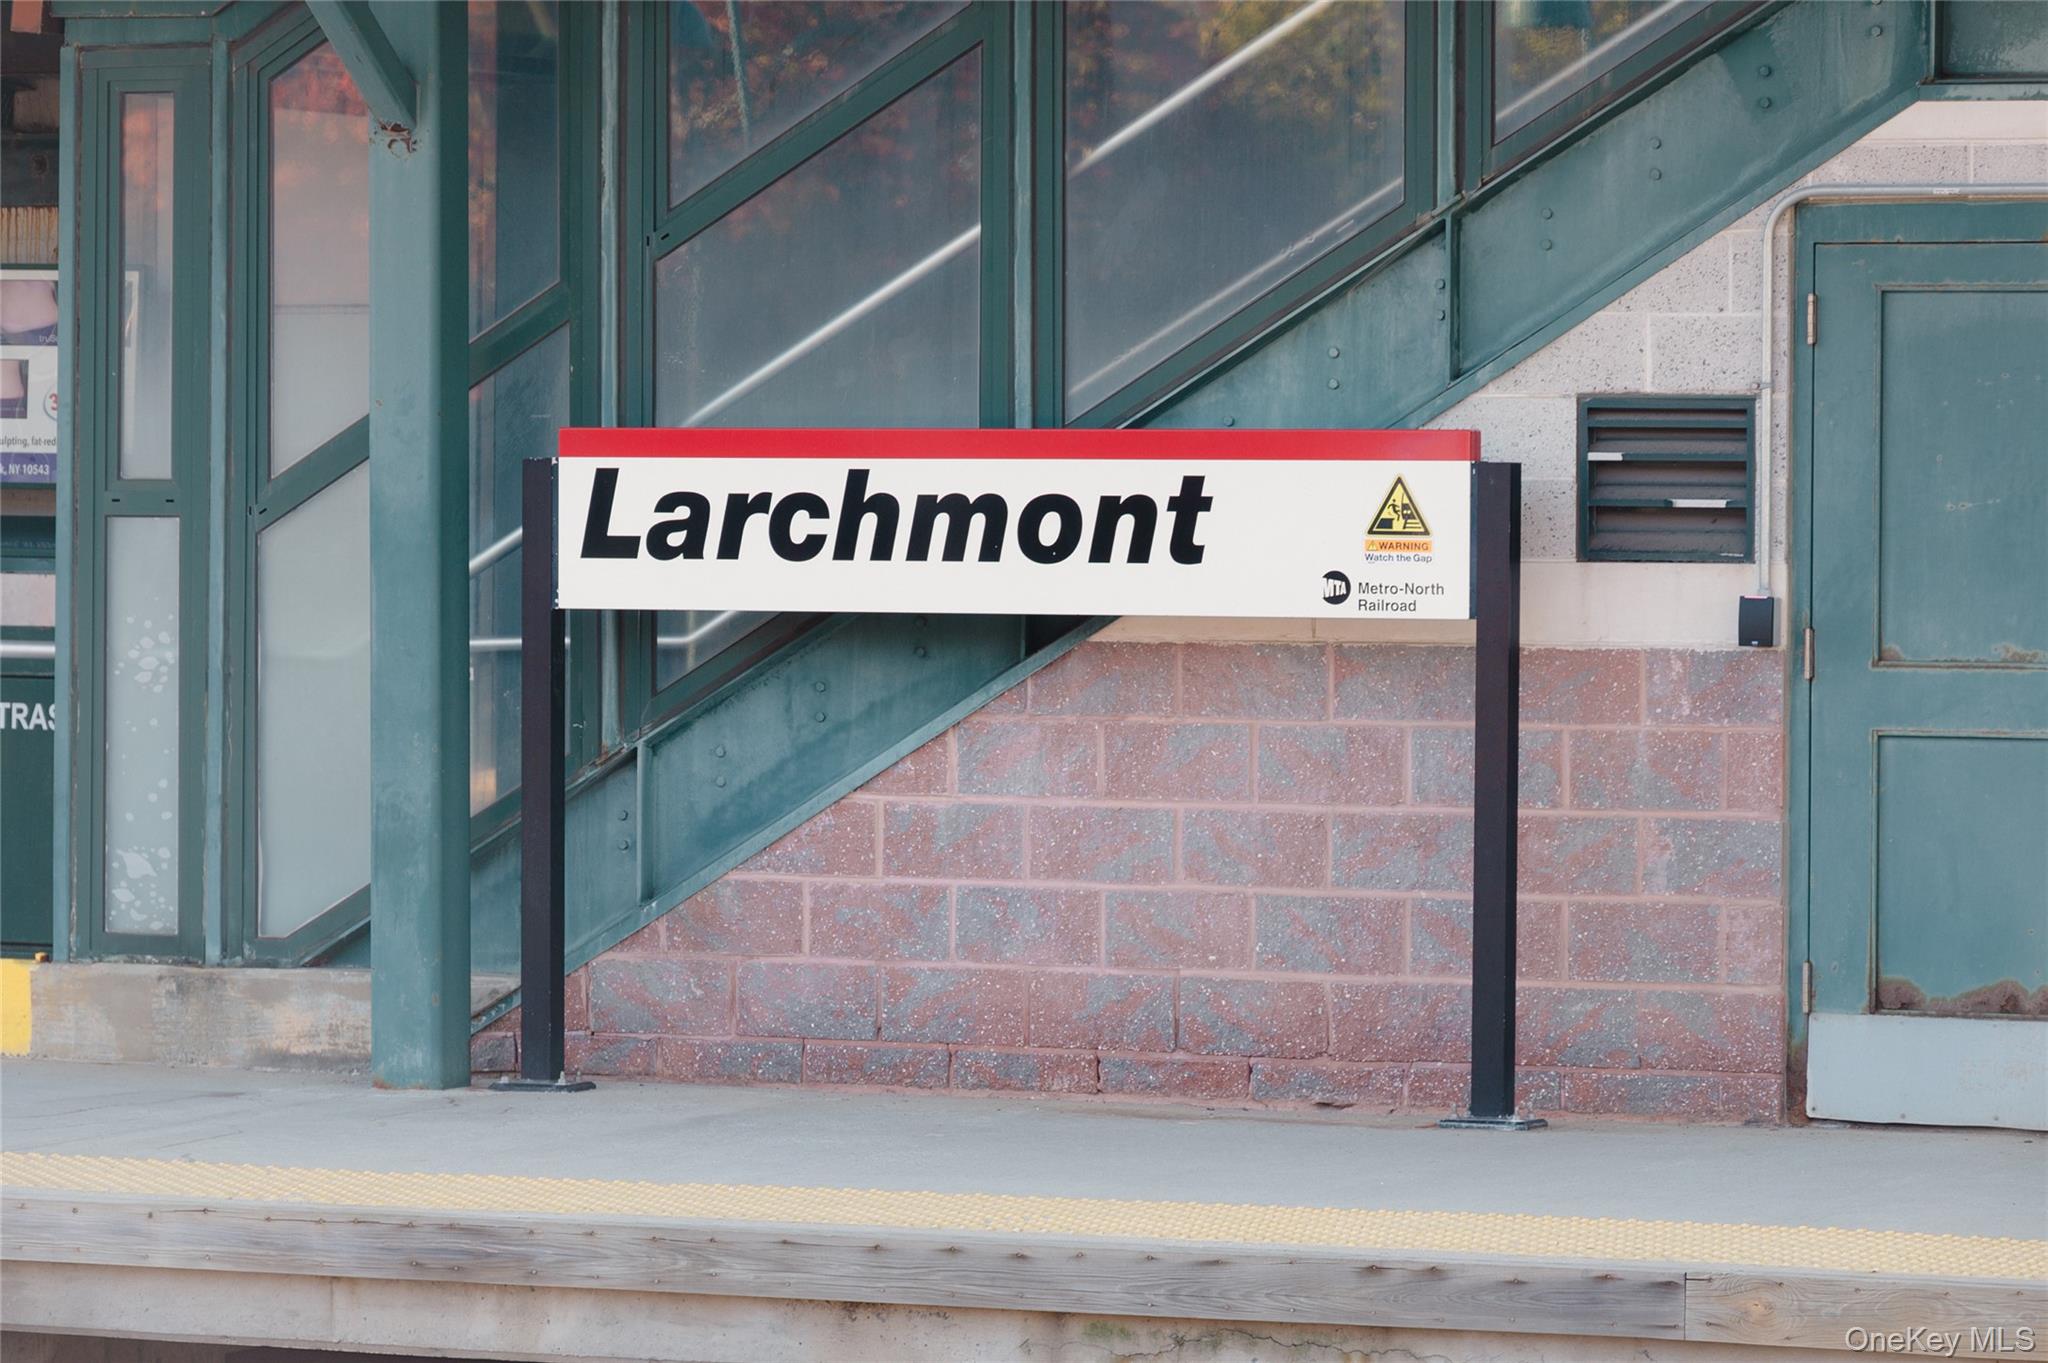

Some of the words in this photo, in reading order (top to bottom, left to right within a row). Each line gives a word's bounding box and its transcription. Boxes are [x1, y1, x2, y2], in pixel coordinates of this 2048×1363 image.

[9, 464, 20, 475] NY
[22, 464, 49, 475] 10543
[580, 467, 1214, 565] Larchmont
[1379, 541, 1429, 551] WARNING
[1365, 553, 1394, 562] Watch
[1396, 554, 1411, 562] the
[1413, 553, 1432, 563] Gap
[1322, 576, 1347, 600] MTA
[1358, 582, 1445, 595] Metro-North
[1358, 599, 1417, 612] Railroad
